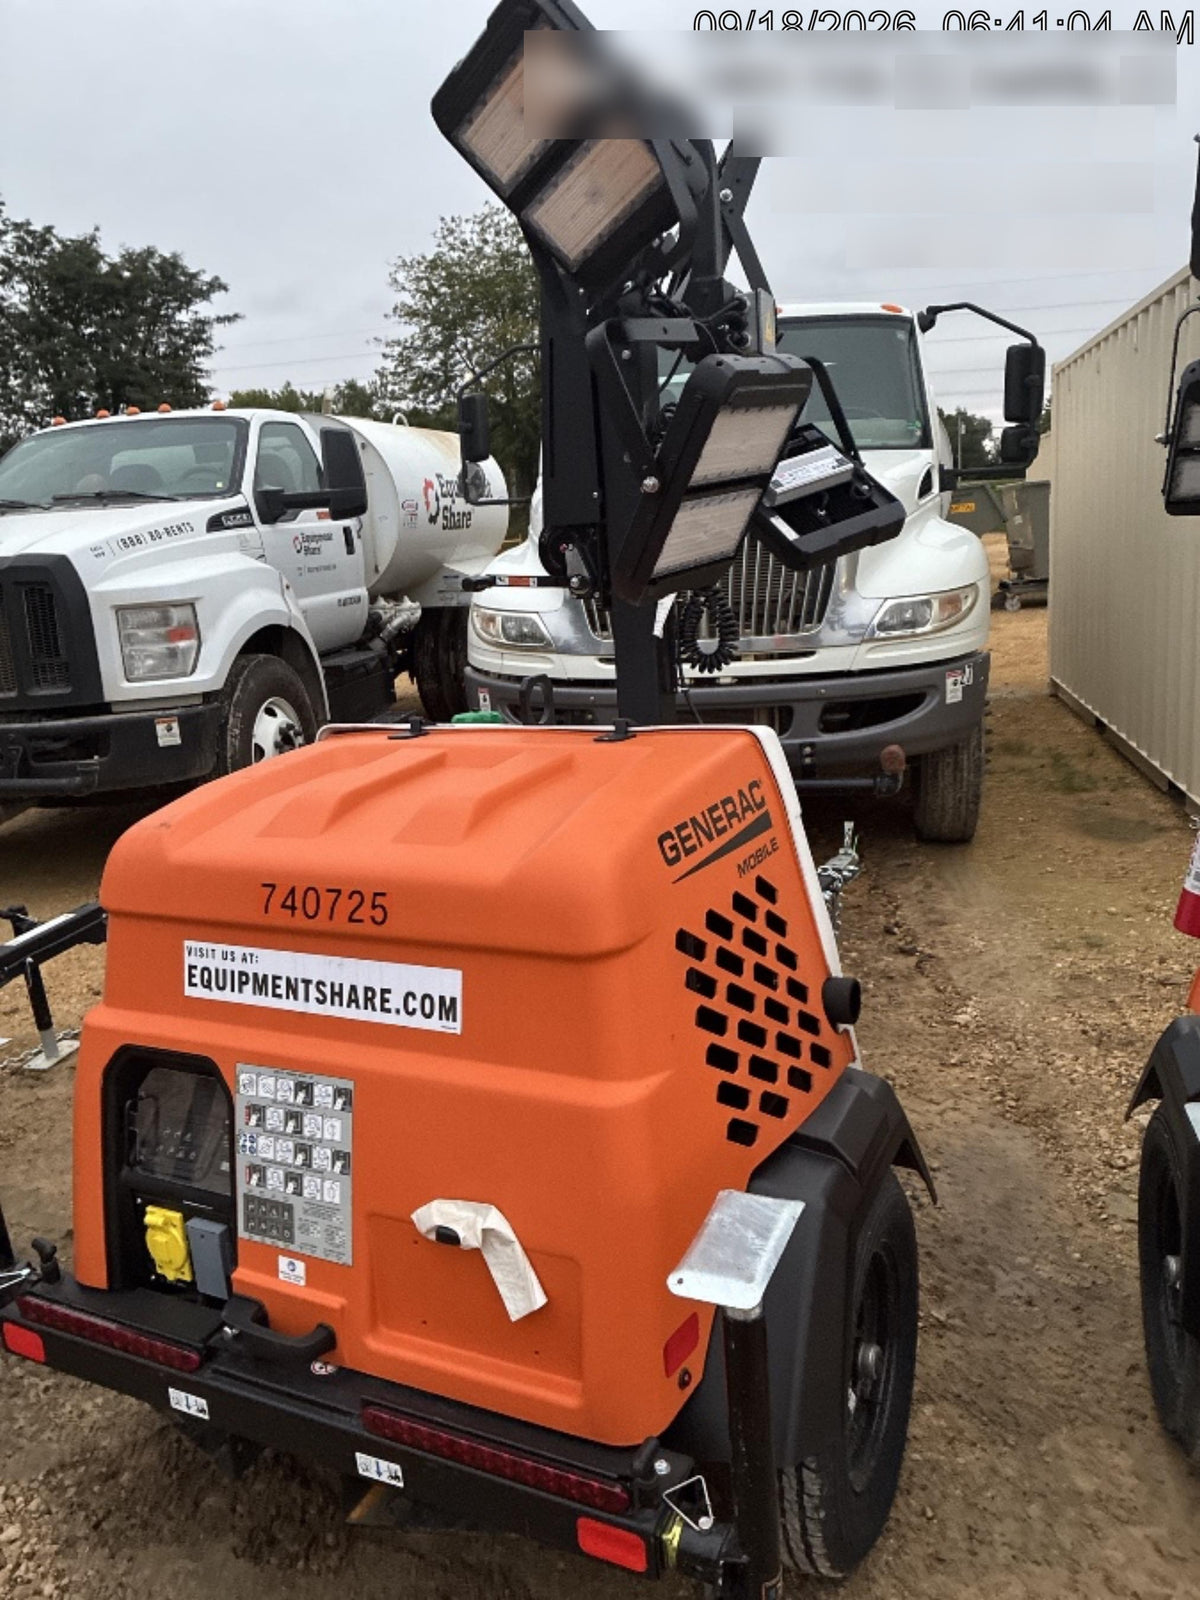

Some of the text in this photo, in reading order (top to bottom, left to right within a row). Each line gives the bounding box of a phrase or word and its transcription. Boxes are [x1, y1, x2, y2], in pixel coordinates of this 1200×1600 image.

[442, 505, 472, 531] Share
[657, 779, 766, 867] GENERAC
[736, 836, 780, 878] MOBILE
[261, 883, 389, 926] 740725
[186, 945, 260, 965] VISIT US AT:
[187, 963, 459, 1024] EQUIPMENTSHARE.COM
